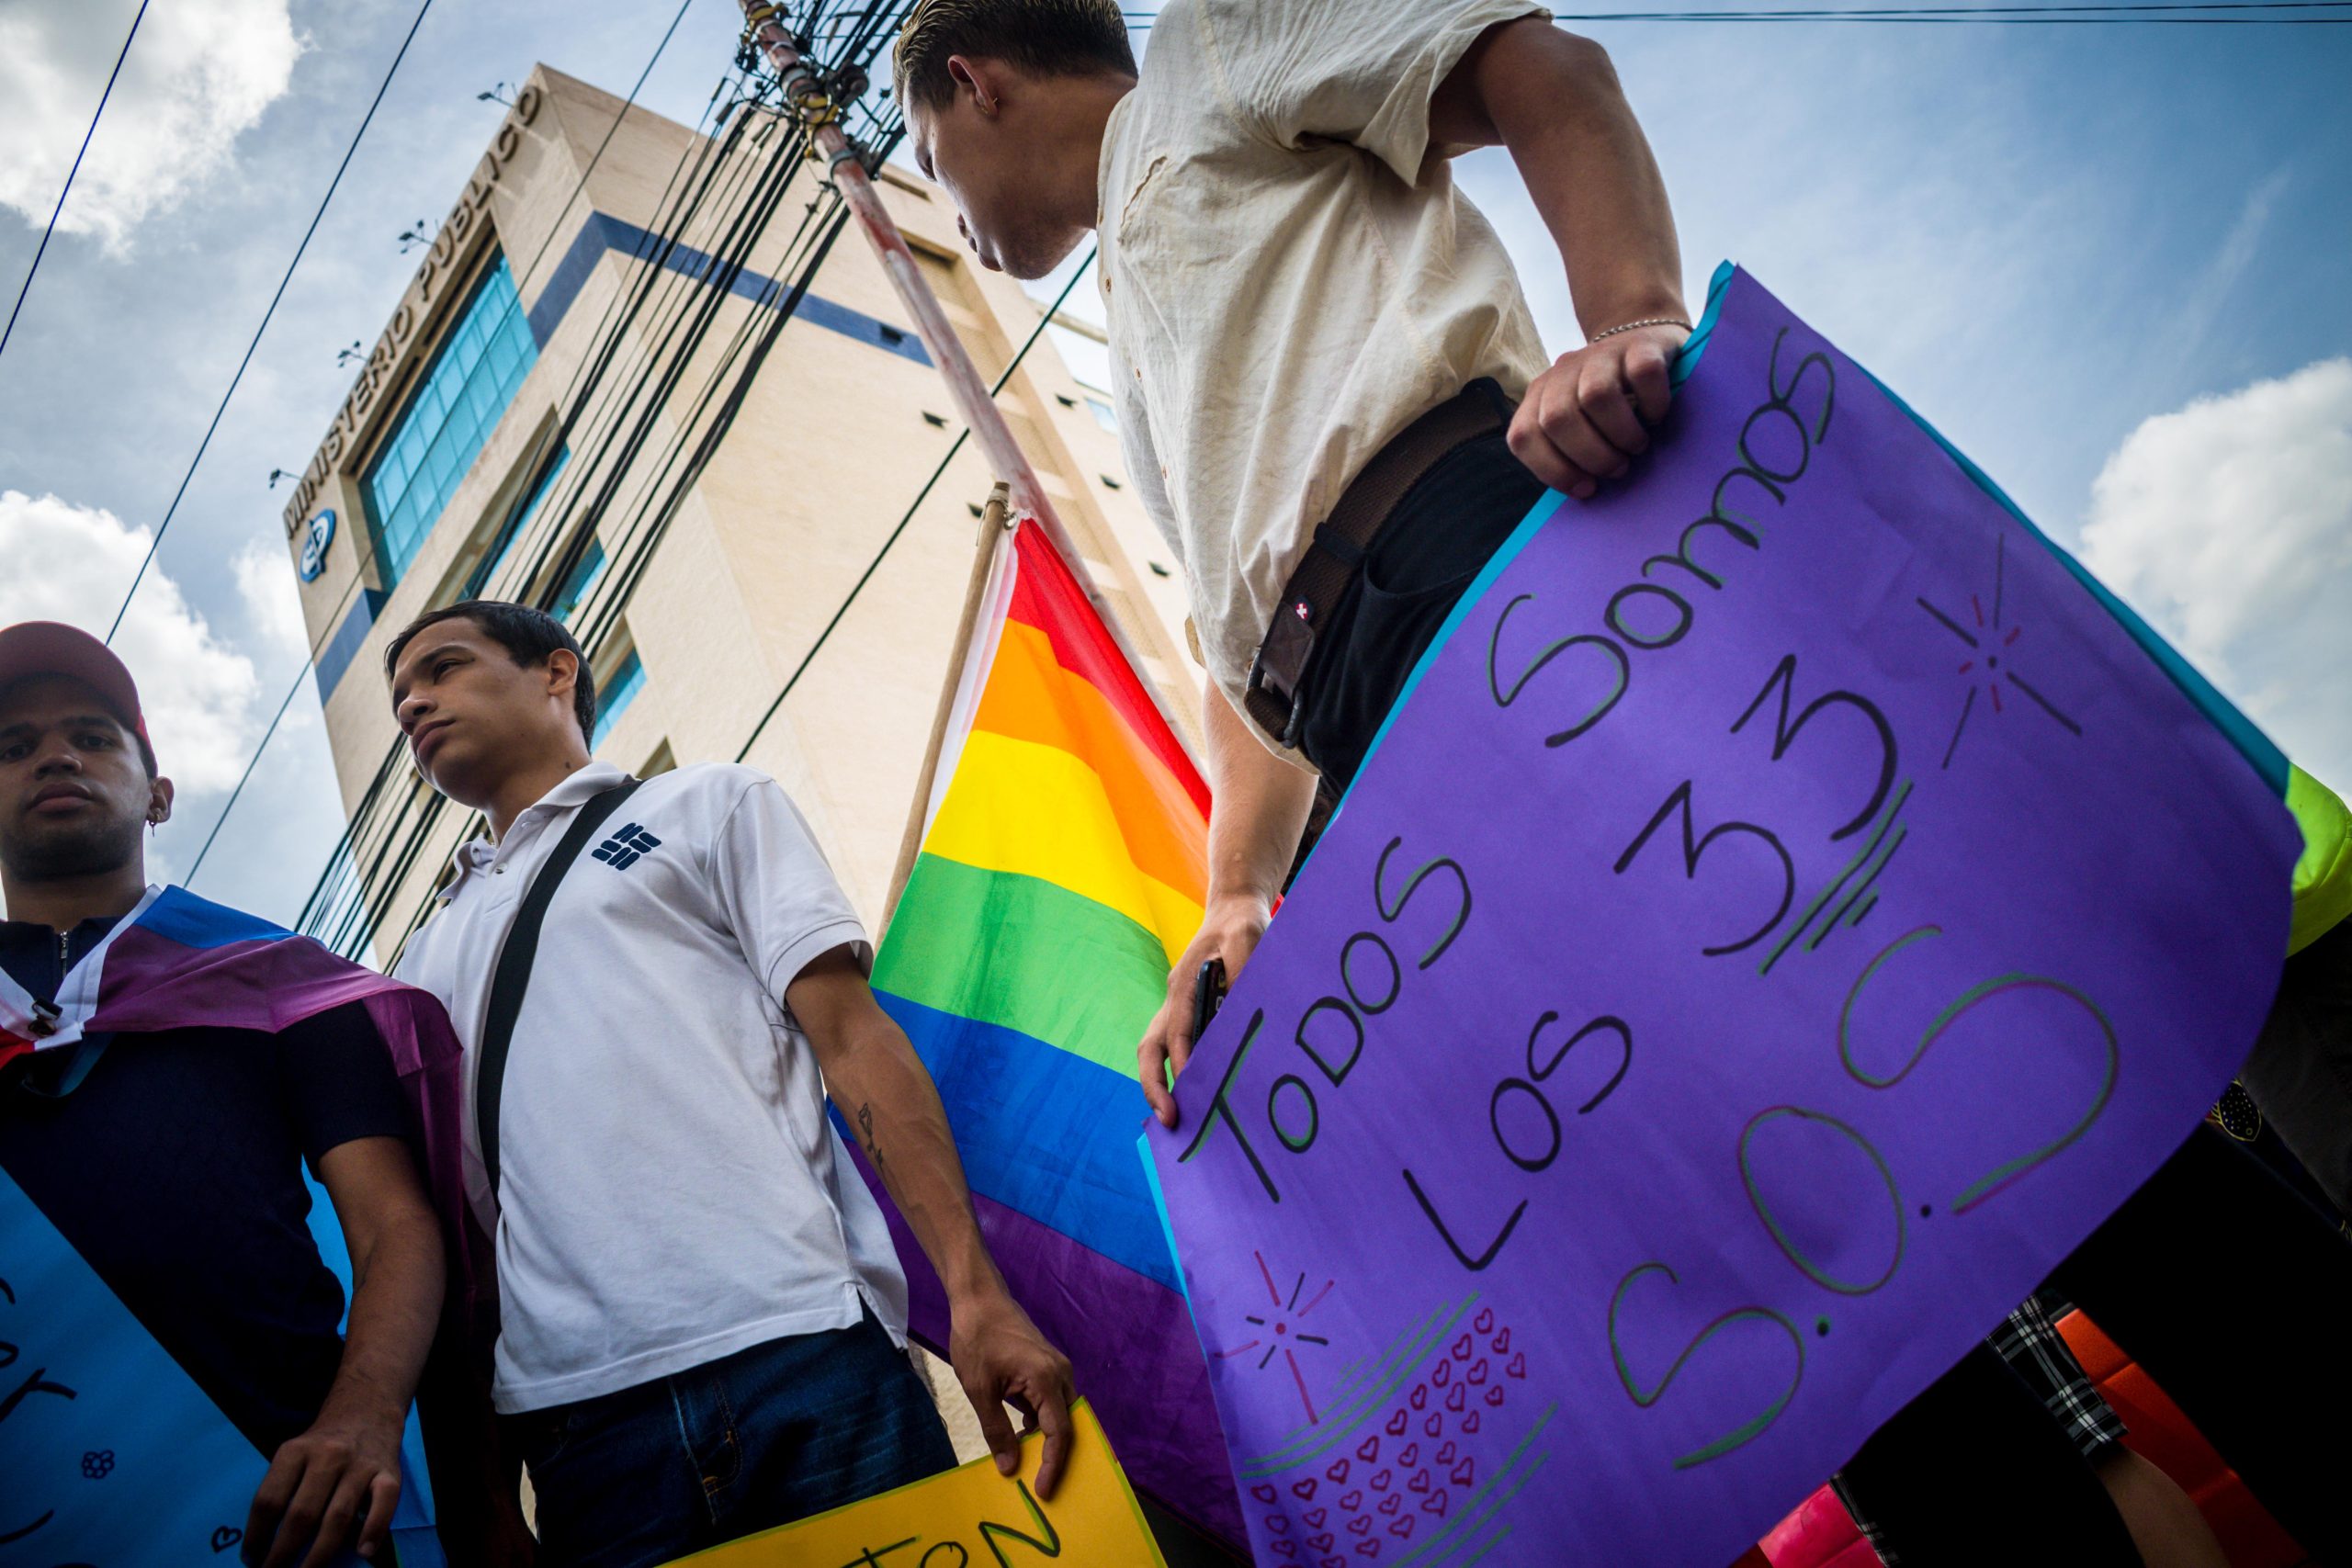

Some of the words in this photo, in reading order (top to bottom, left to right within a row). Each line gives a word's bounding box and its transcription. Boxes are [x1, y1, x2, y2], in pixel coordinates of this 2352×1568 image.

[285, 304, 413, 540] MINISTERIO
[416, 85, 541, 302] PUBLICO
[1612, 653, 1898, 957] 33
